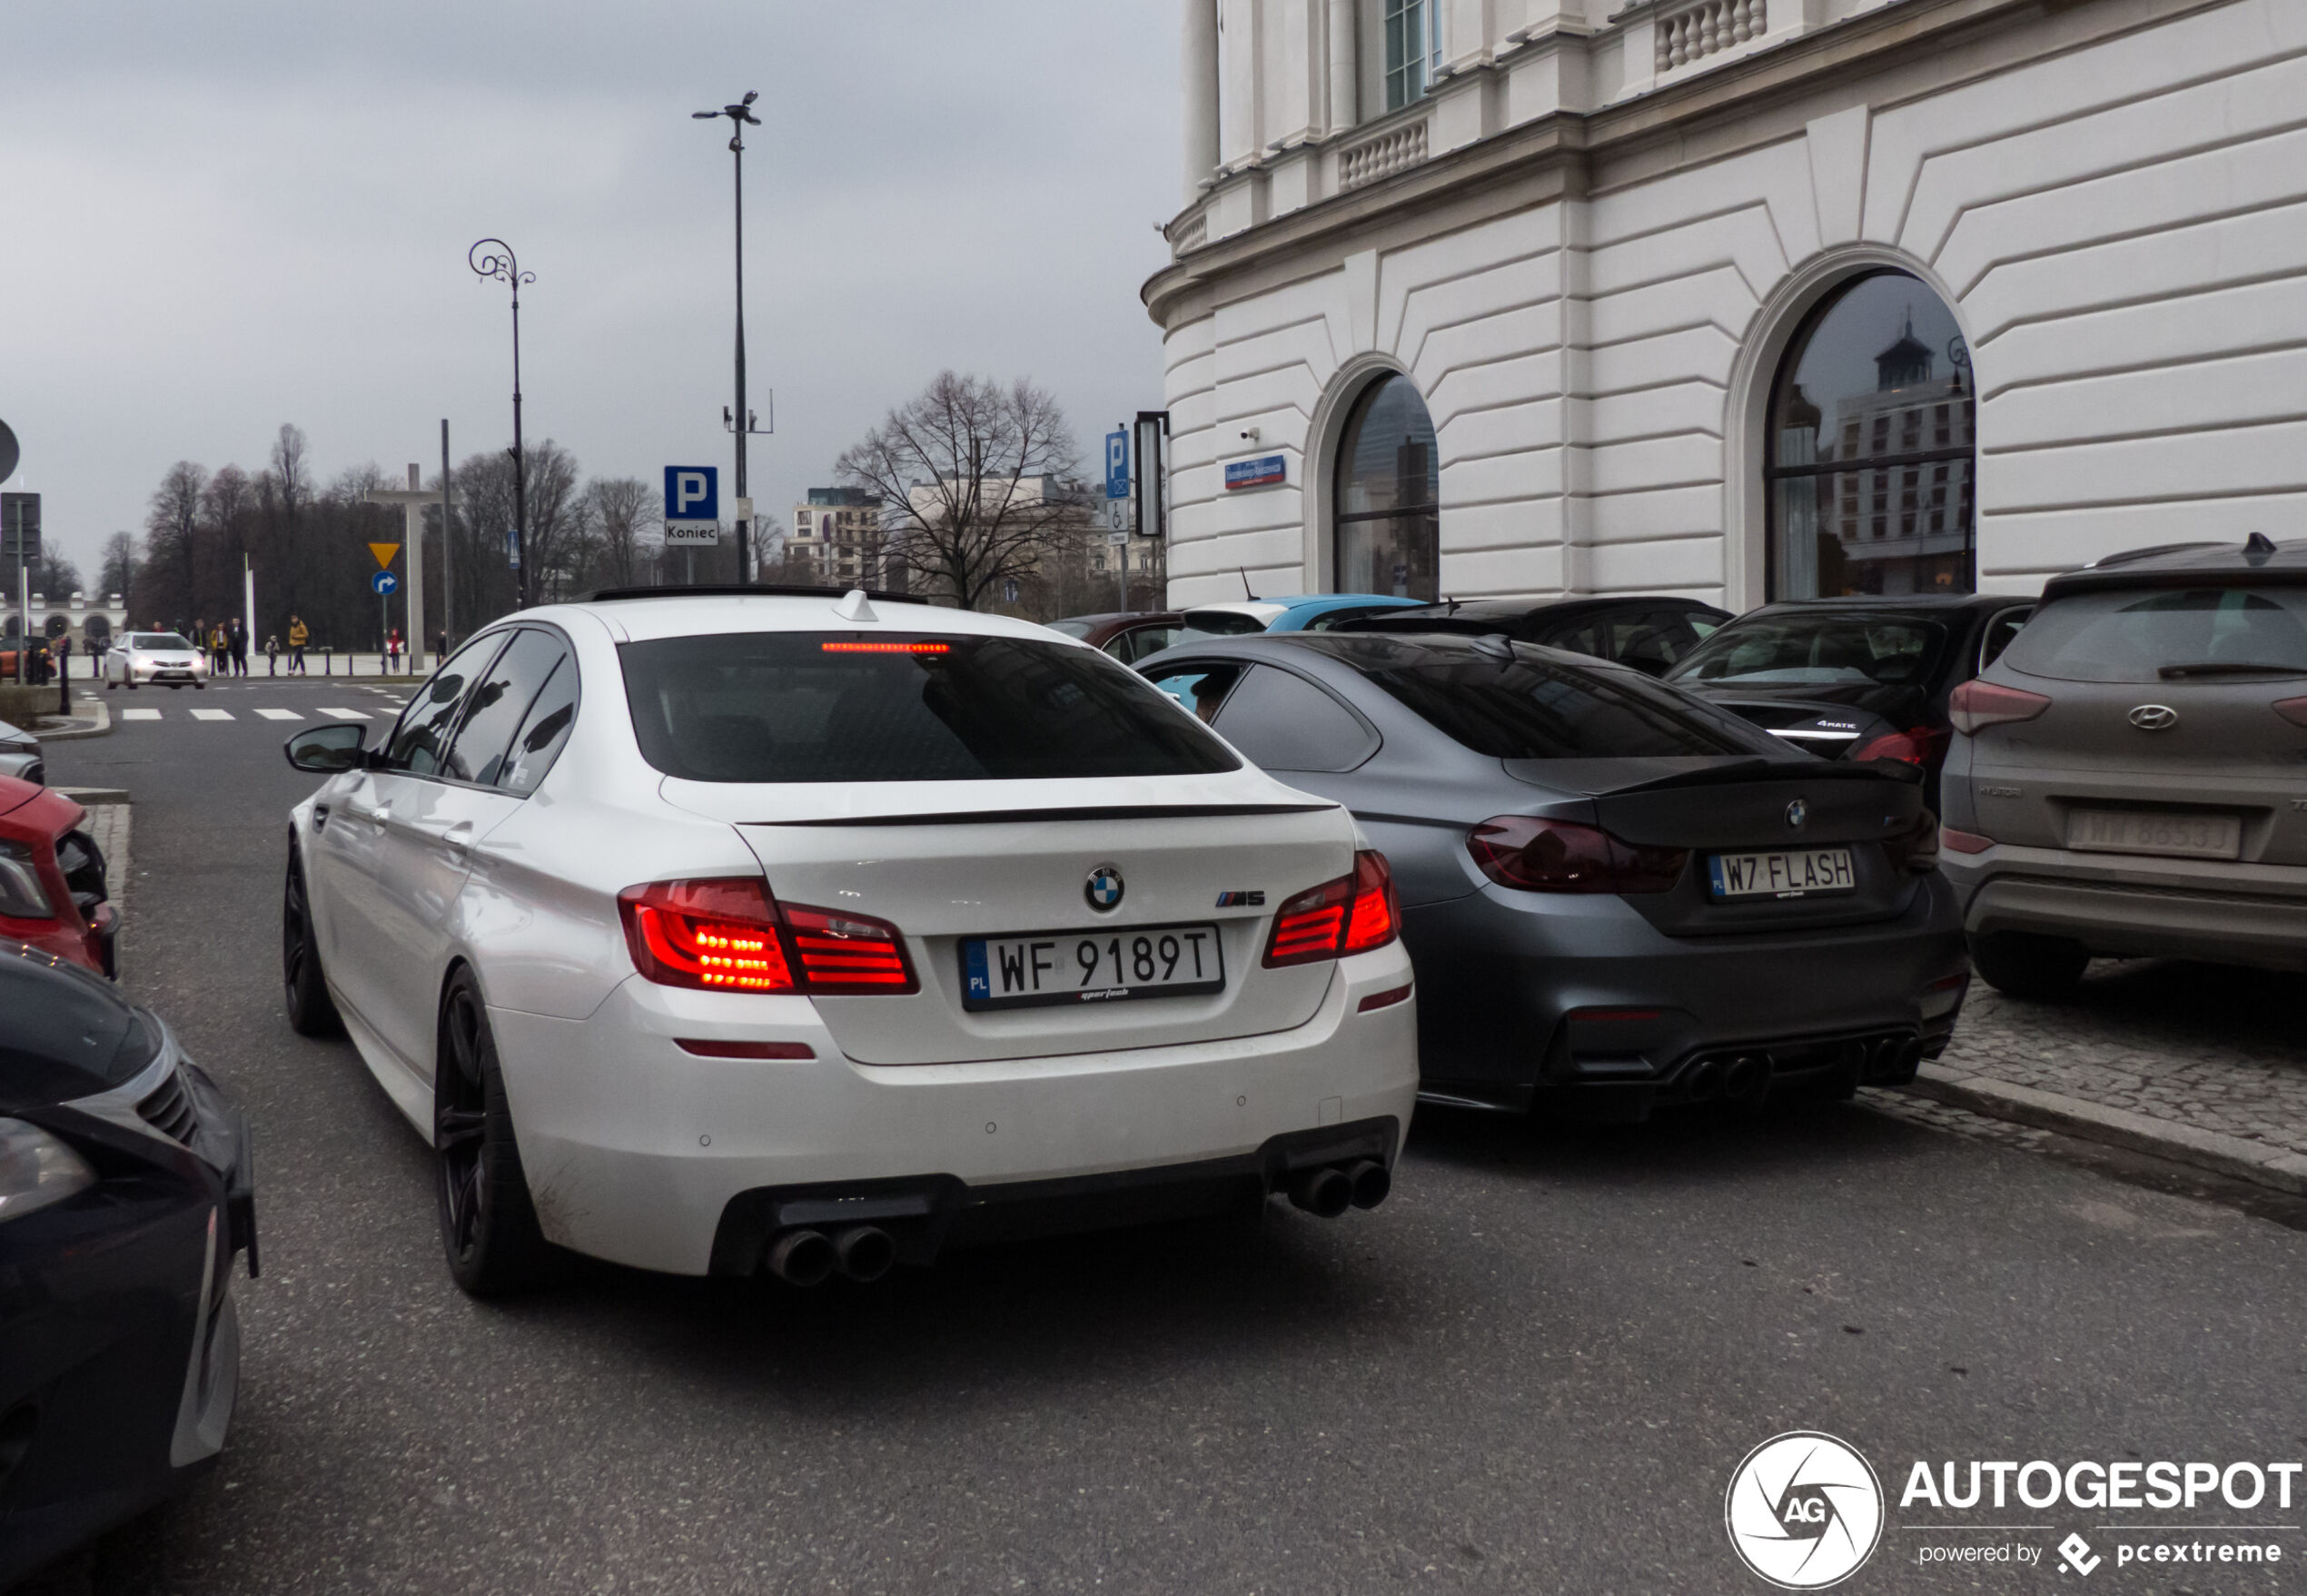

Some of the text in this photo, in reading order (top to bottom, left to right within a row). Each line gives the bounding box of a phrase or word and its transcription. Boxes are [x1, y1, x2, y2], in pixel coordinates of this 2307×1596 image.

[677, 471, 708, 513] P
[668, 526, 716, 539] Koniec
[1817, 720, 1856, 729] 4MATIC
[1726, 852, 1851, 891] W7 FLASH
[1713, 880, 1724, 890] PL
[998, 932, 1206, 992] WF 9189T
[970, 976, 986, 991] PL
